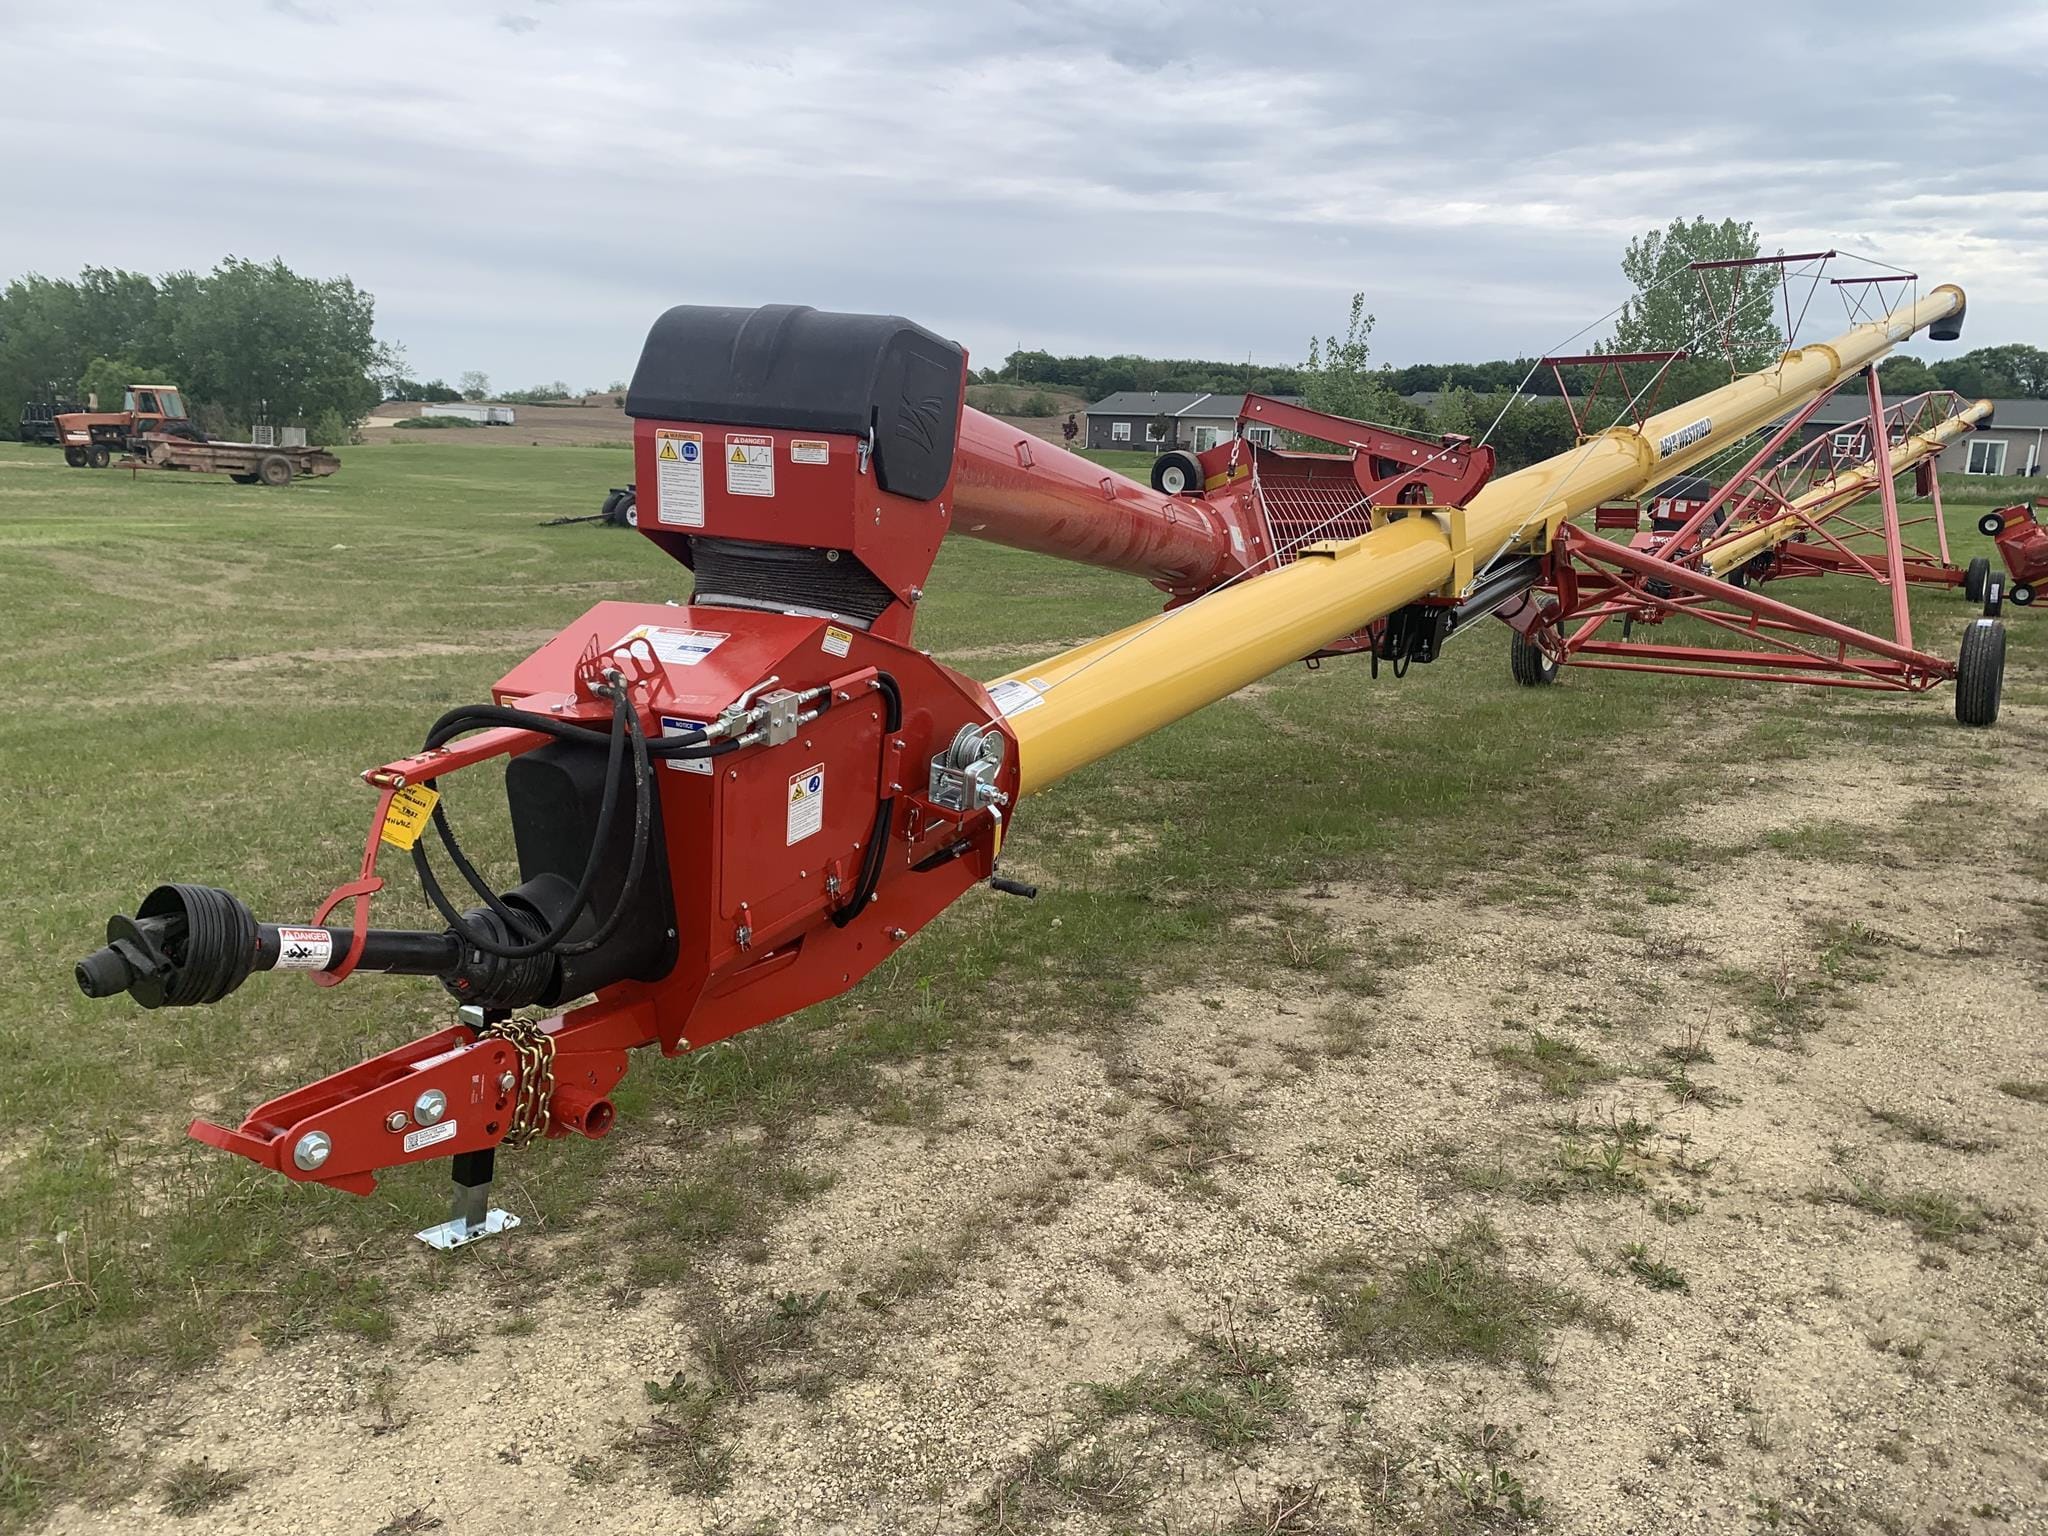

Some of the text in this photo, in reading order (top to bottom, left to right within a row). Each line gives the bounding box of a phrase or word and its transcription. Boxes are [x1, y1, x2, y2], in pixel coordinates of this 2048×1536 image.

[1677, 418, 1712, 450] WESTFIELD
[675, 721, 694, 730] NOTICE
[294, 931, 328, 941] DANGER
